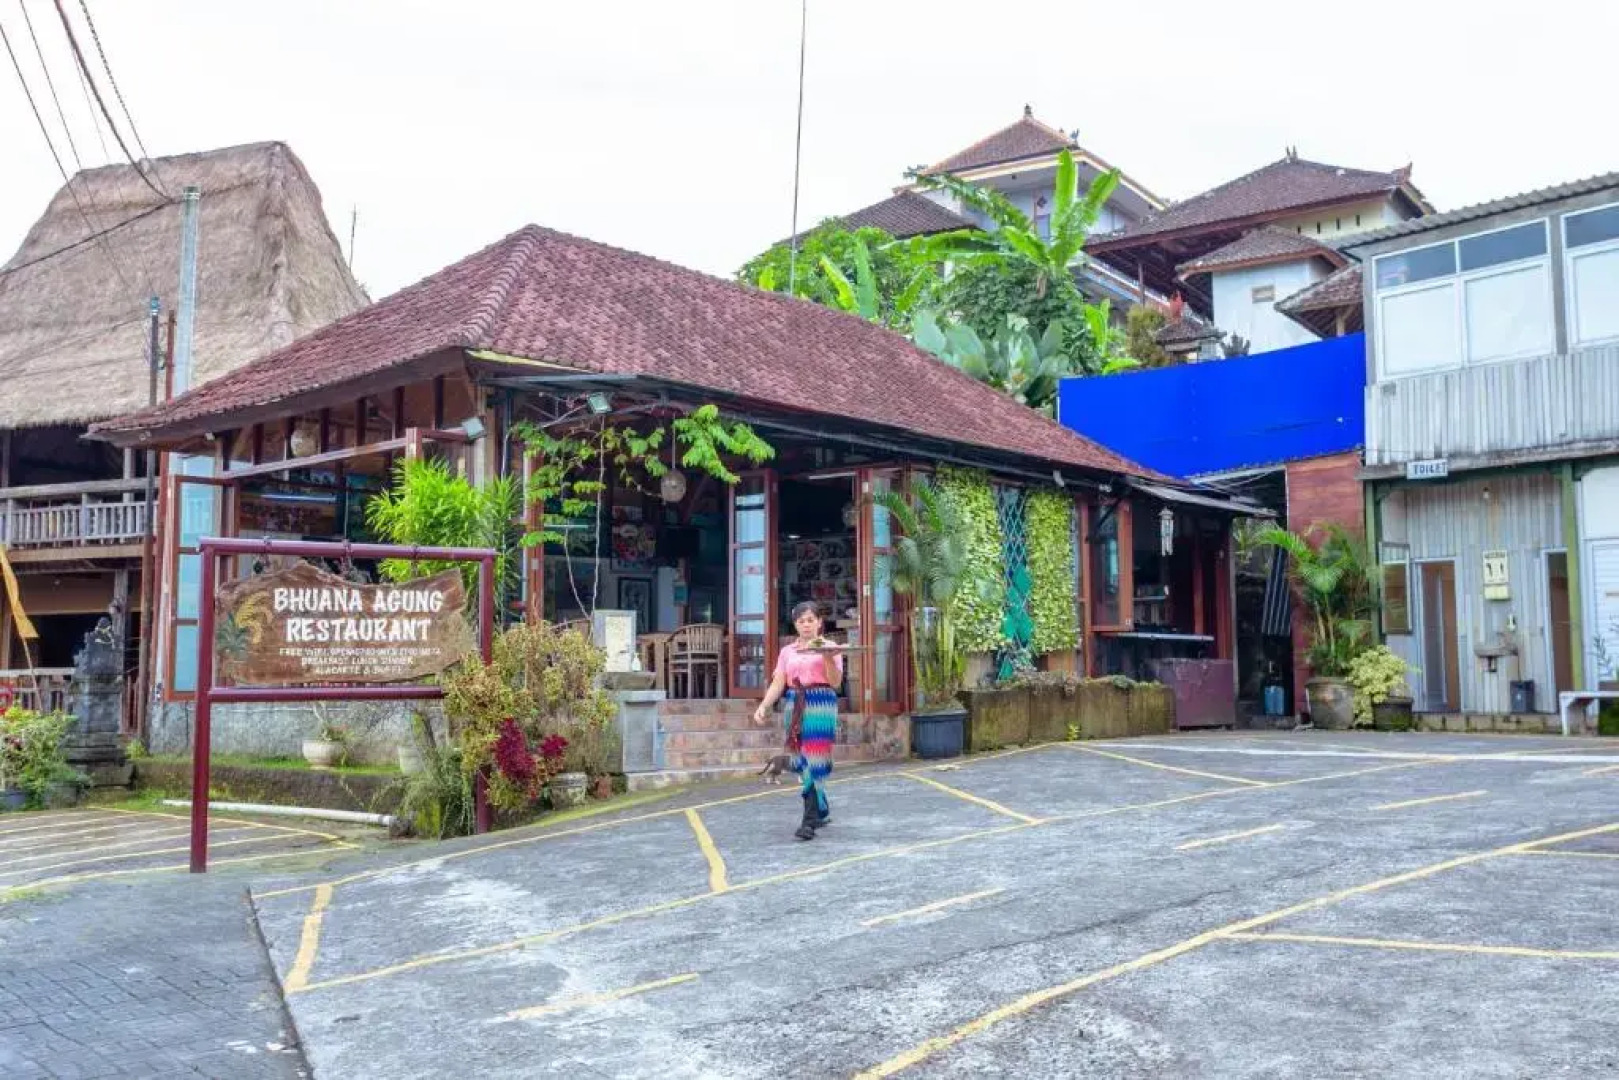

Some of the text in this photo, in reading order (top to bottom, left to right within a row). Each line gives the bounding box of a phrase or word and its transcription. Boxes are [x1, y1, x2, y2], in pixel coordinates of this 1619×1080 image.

[1413, 462, 1446, 475] TOILET
[274, 588, 444, 613] BHUANA AGUNG
[286, 617, 431, 642] RESTAURANT
[301, 657, 349, 666] BREAKFAST
